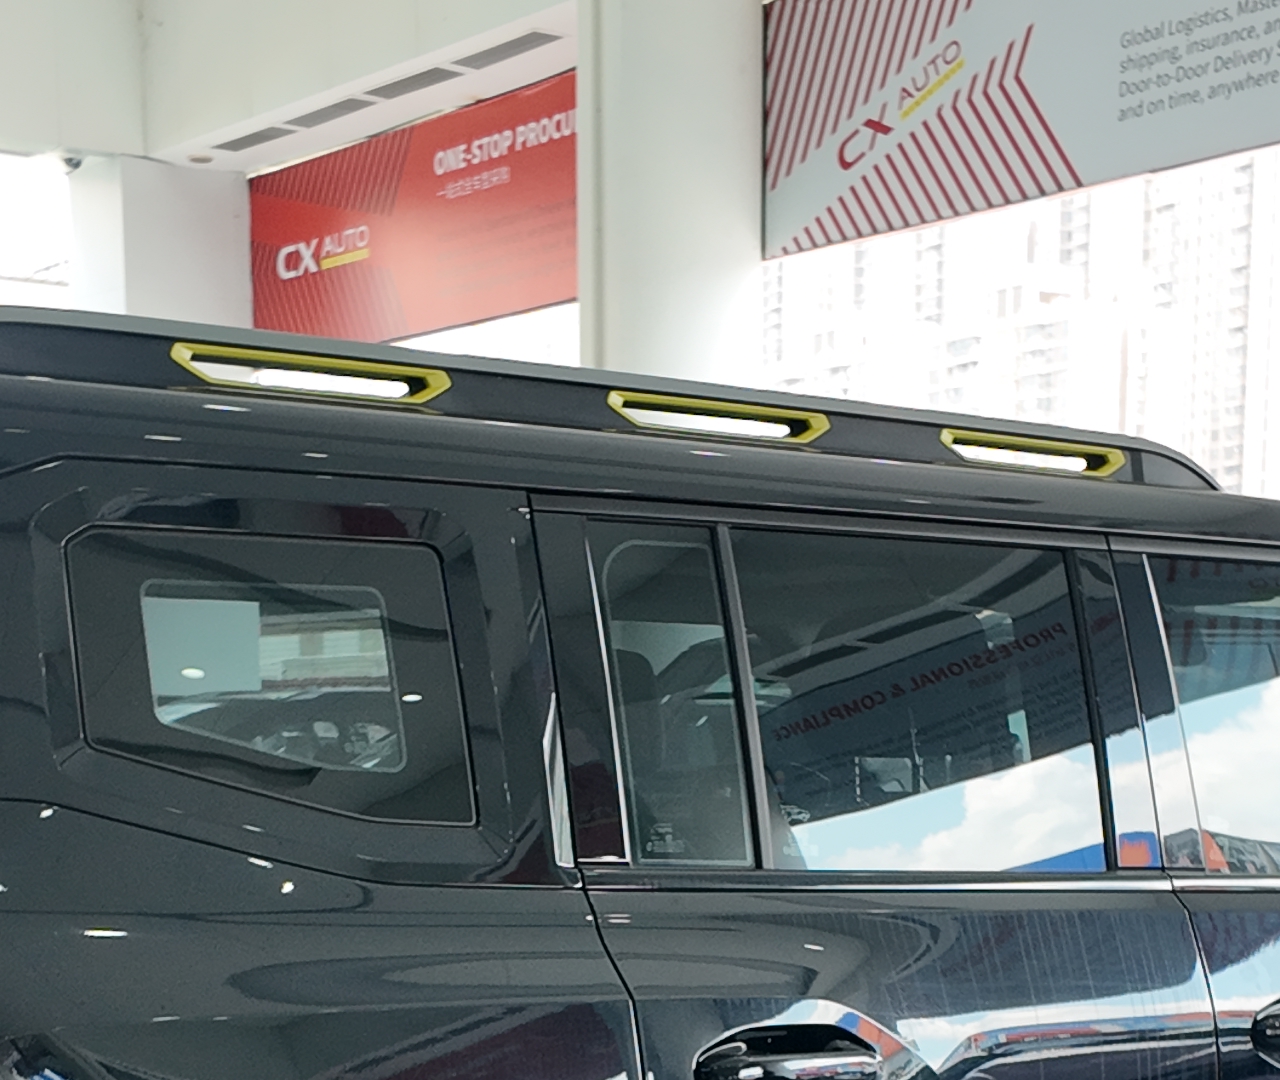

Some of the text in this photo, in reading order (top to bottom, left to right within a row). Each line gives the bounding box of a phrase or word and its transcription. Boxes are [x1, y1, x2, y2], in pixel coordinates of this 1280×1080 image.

[1119, 45, 1182, 73] shipping,
[1185, 24, 1260, 56] insurance,
[1120, 21, 1165, 49] Global
[1168, 6, 1233, 37] Logistics,
[1118, 61, 1210, 98] Door-to-Door
[1213, 46, 1273, 74] Delivery
[1118, 99, 1143, 122] and
[1146, 98, 1165, 115] on
[1169, 89, 1204, 110] time,
[1207, 68, 1279, 100] anywhere
[837, 40, 960, 171] CX AUTO
[433, 130, 512, 176] ONE-STOP
[276, 225, 370, 280] CX AUTO
